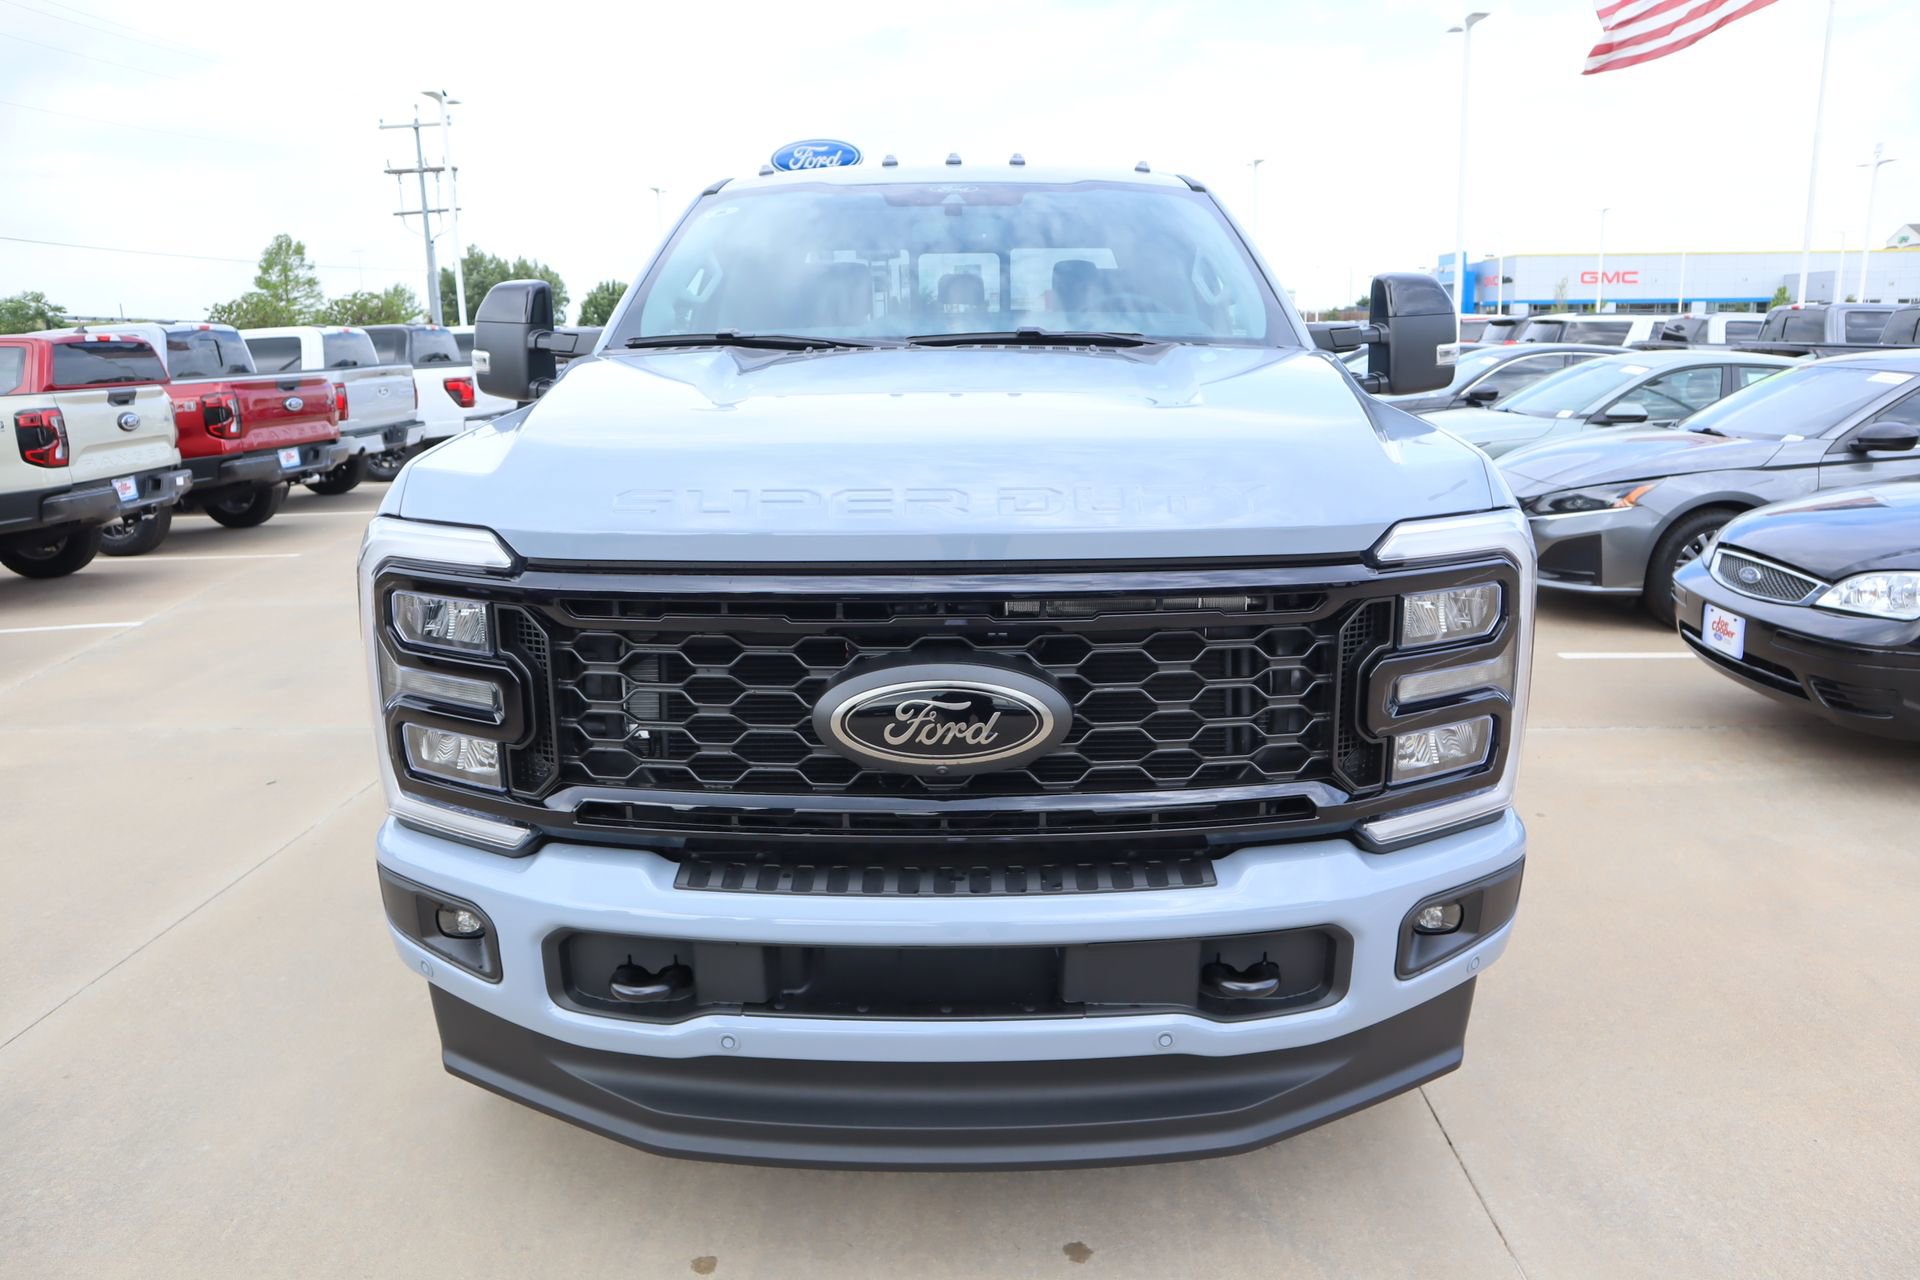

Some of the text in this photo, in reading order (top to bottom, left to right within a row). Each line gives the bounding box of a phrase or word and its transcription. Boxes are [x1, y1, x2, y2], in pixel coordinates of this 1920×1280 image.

[789, 145, 843, 169] Ford
[1579, 271, 1639, 285] GMC
[612, 487, 970, 519] SUPER
[883, 699, 1001, 746] Ford
